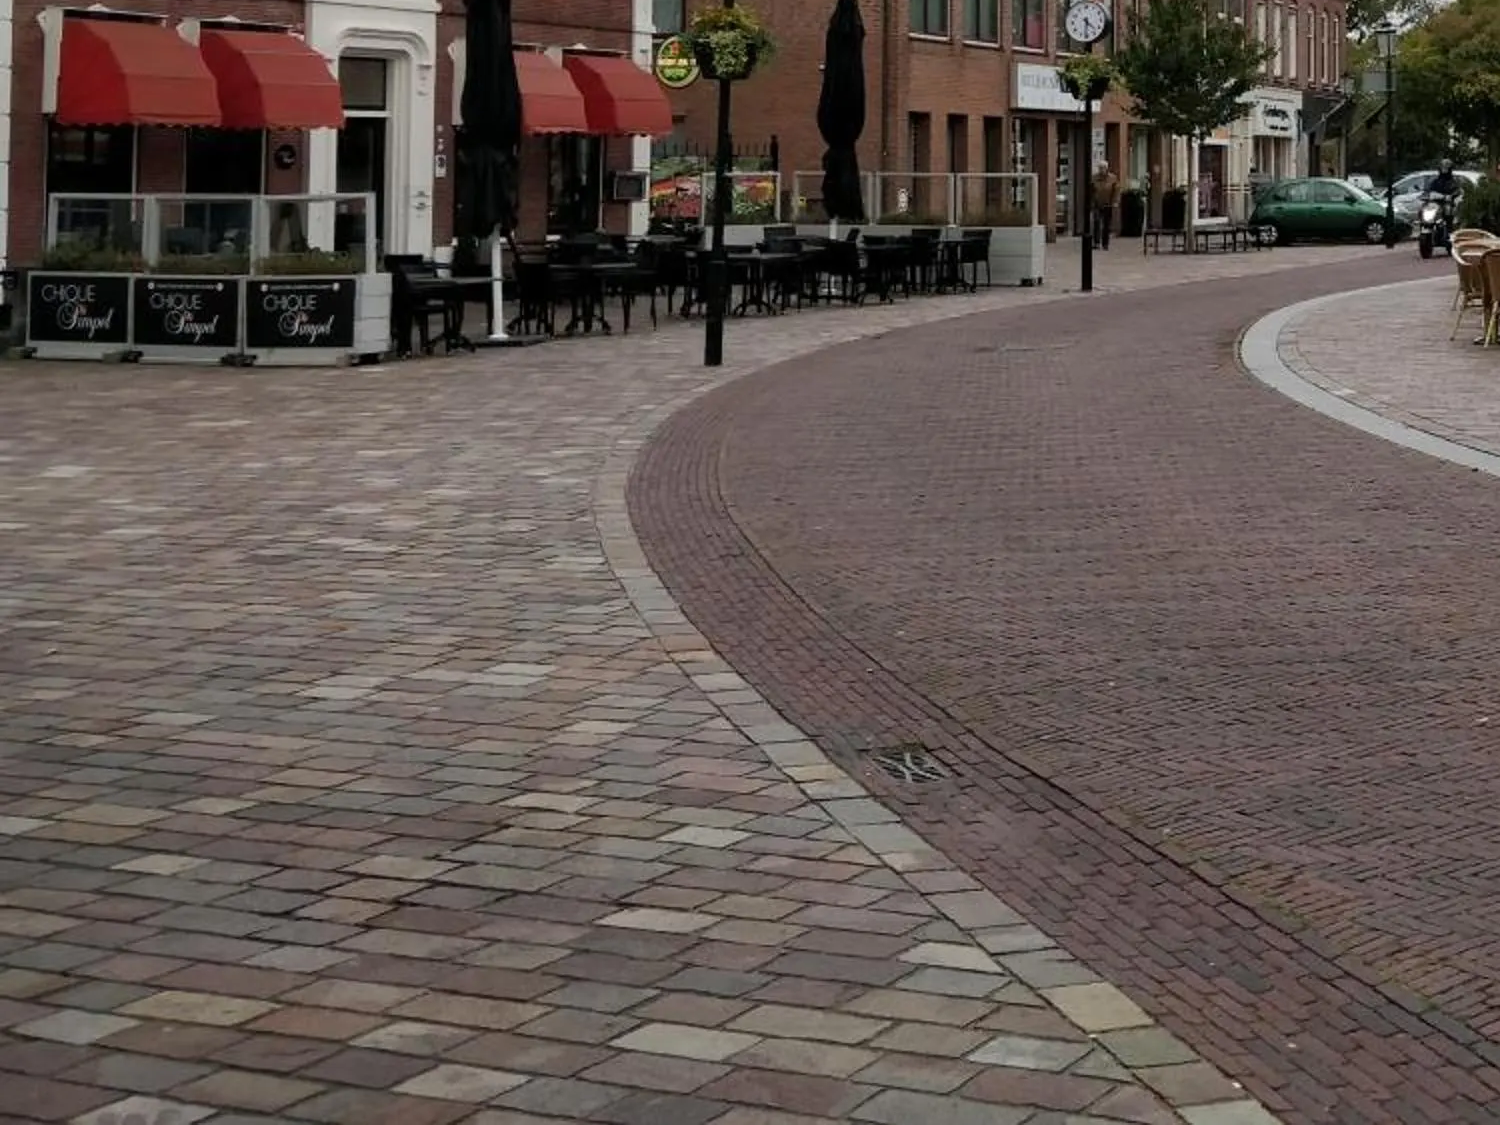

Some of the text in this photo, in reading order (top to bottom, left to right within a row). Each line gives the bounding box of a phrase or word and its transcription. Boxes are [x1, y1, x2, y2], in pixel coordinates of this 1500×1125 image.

[41, 283, 97, 303] CHIQUE
[149, 292, 204, 310] CHIQUE
[263, 294, 319, 311] CHIQUE
